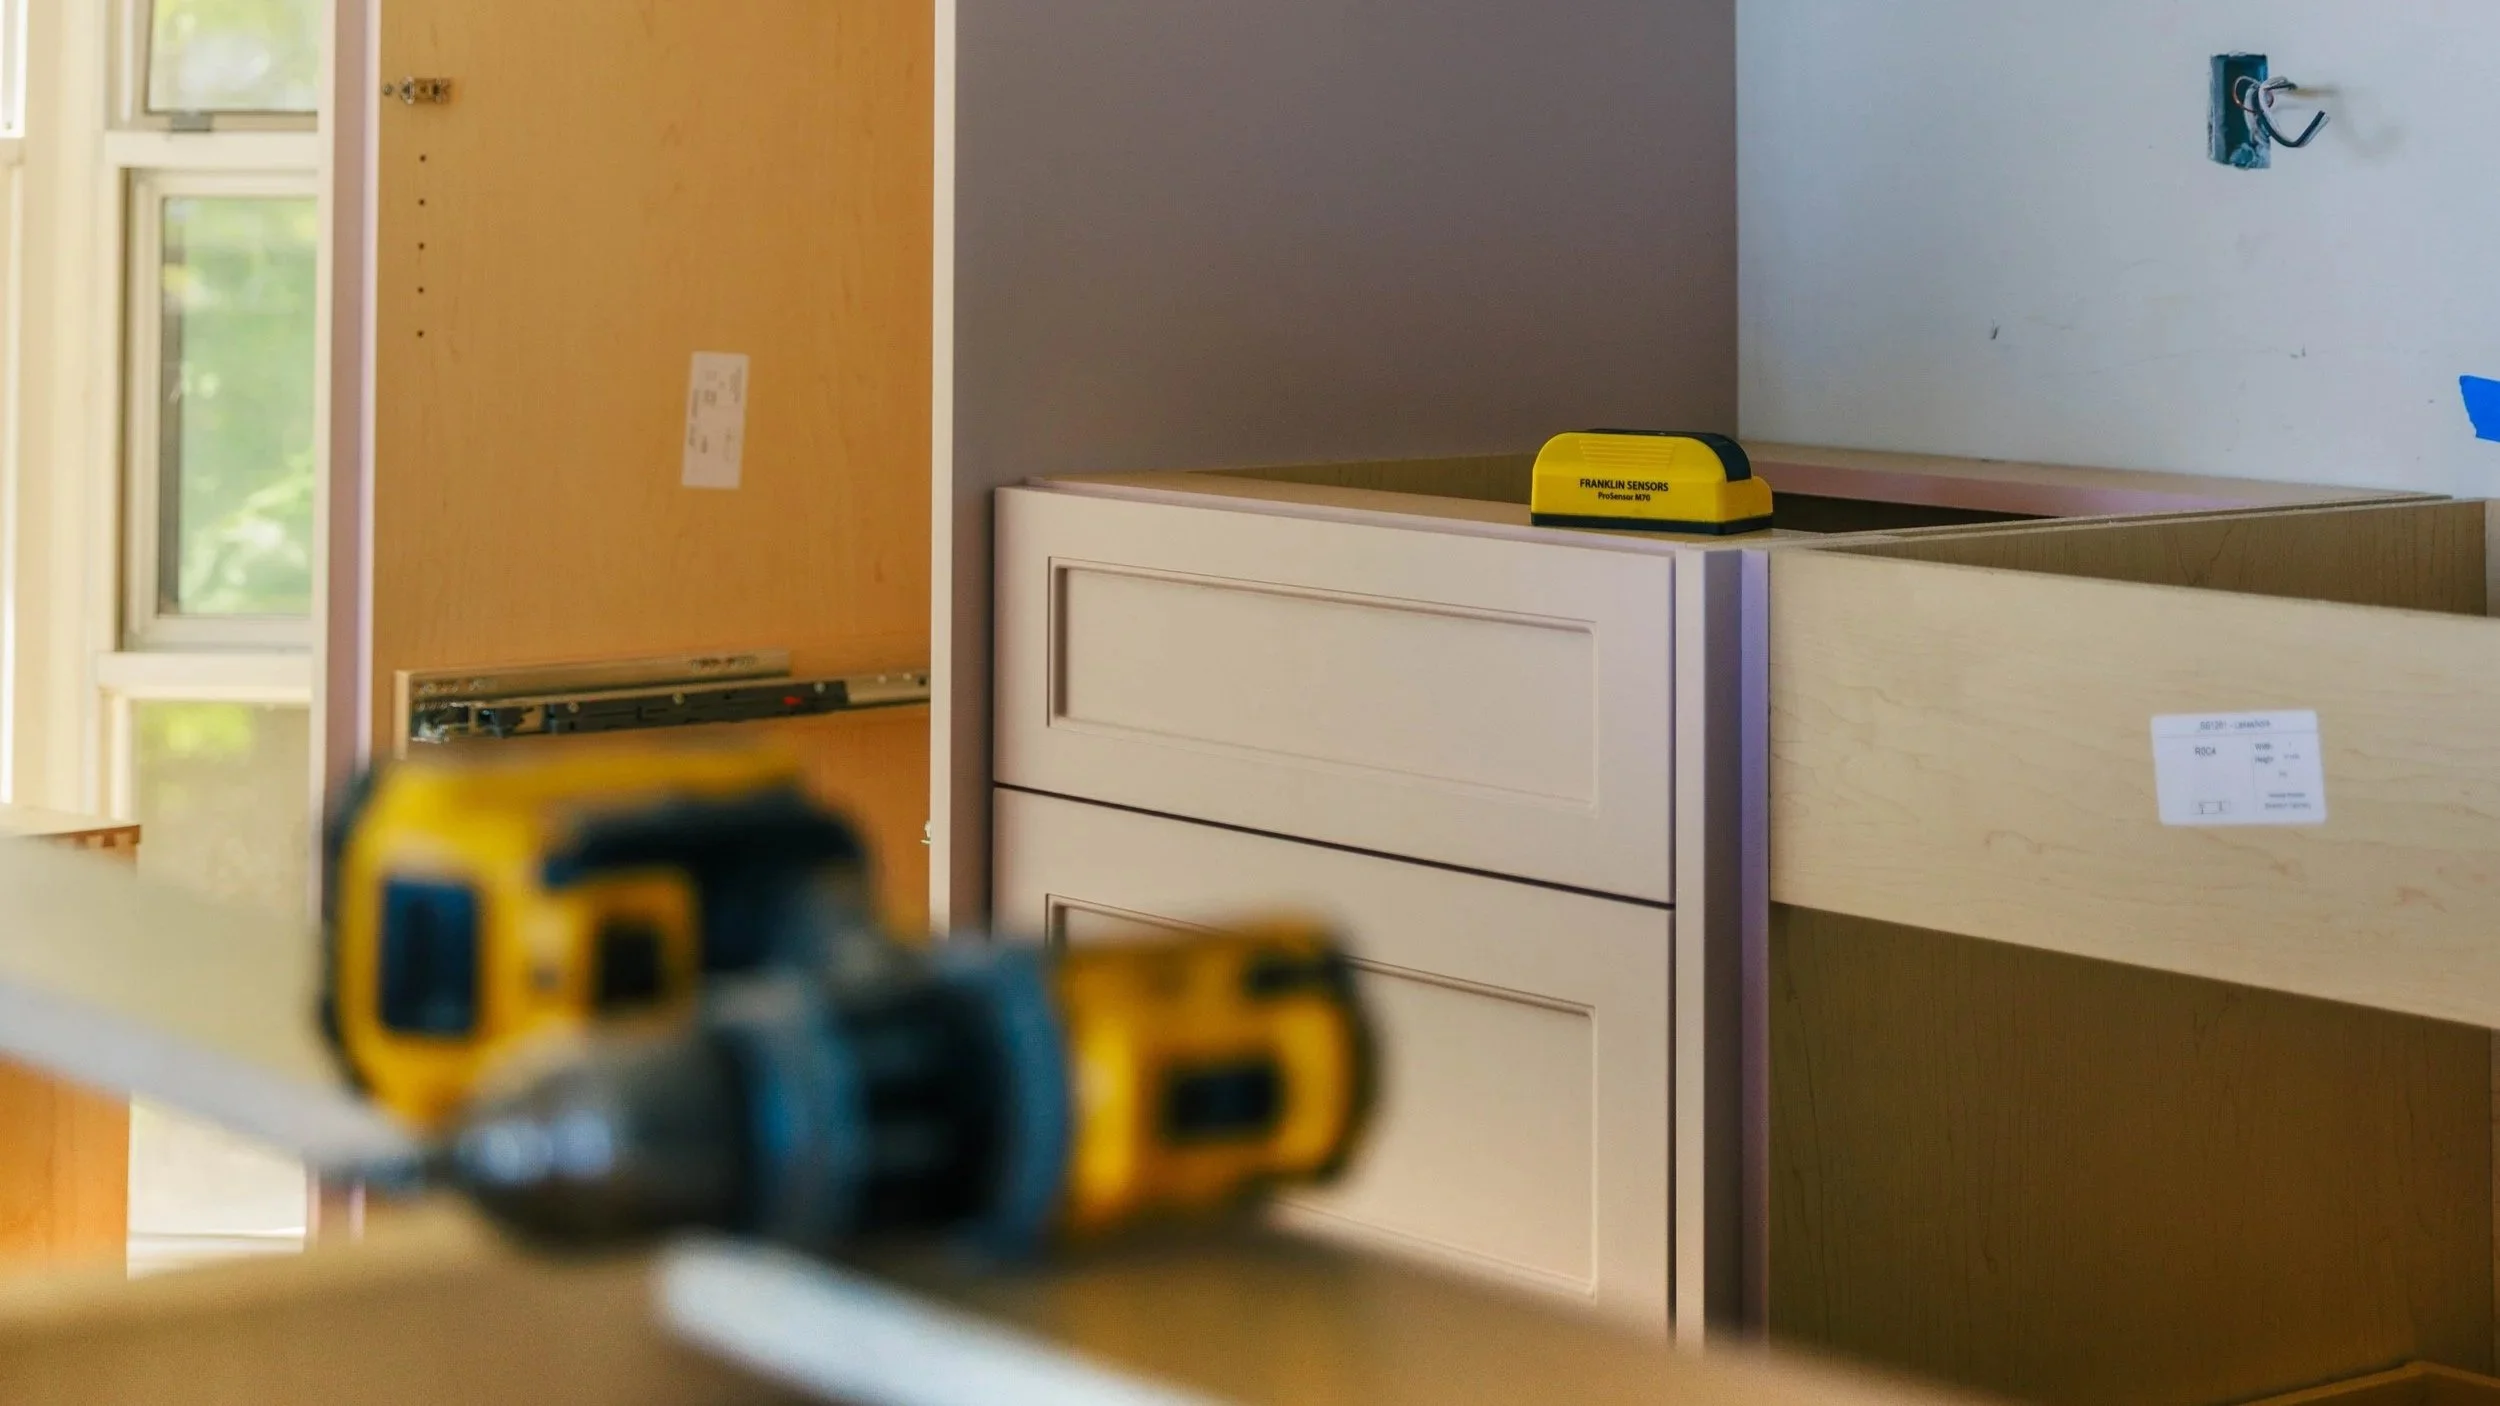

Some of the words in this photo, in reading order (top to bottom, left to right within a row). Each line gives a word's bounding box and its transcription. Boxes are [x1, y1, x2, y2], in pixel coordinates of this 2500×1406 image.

[1579, 478, 1625, 490] FRANKLIN
[1627, 480, 1669, 492] SENSORS
[1597, 491, 1634, 501] ProSensor
[1635, 493, 1651, 502] M70
